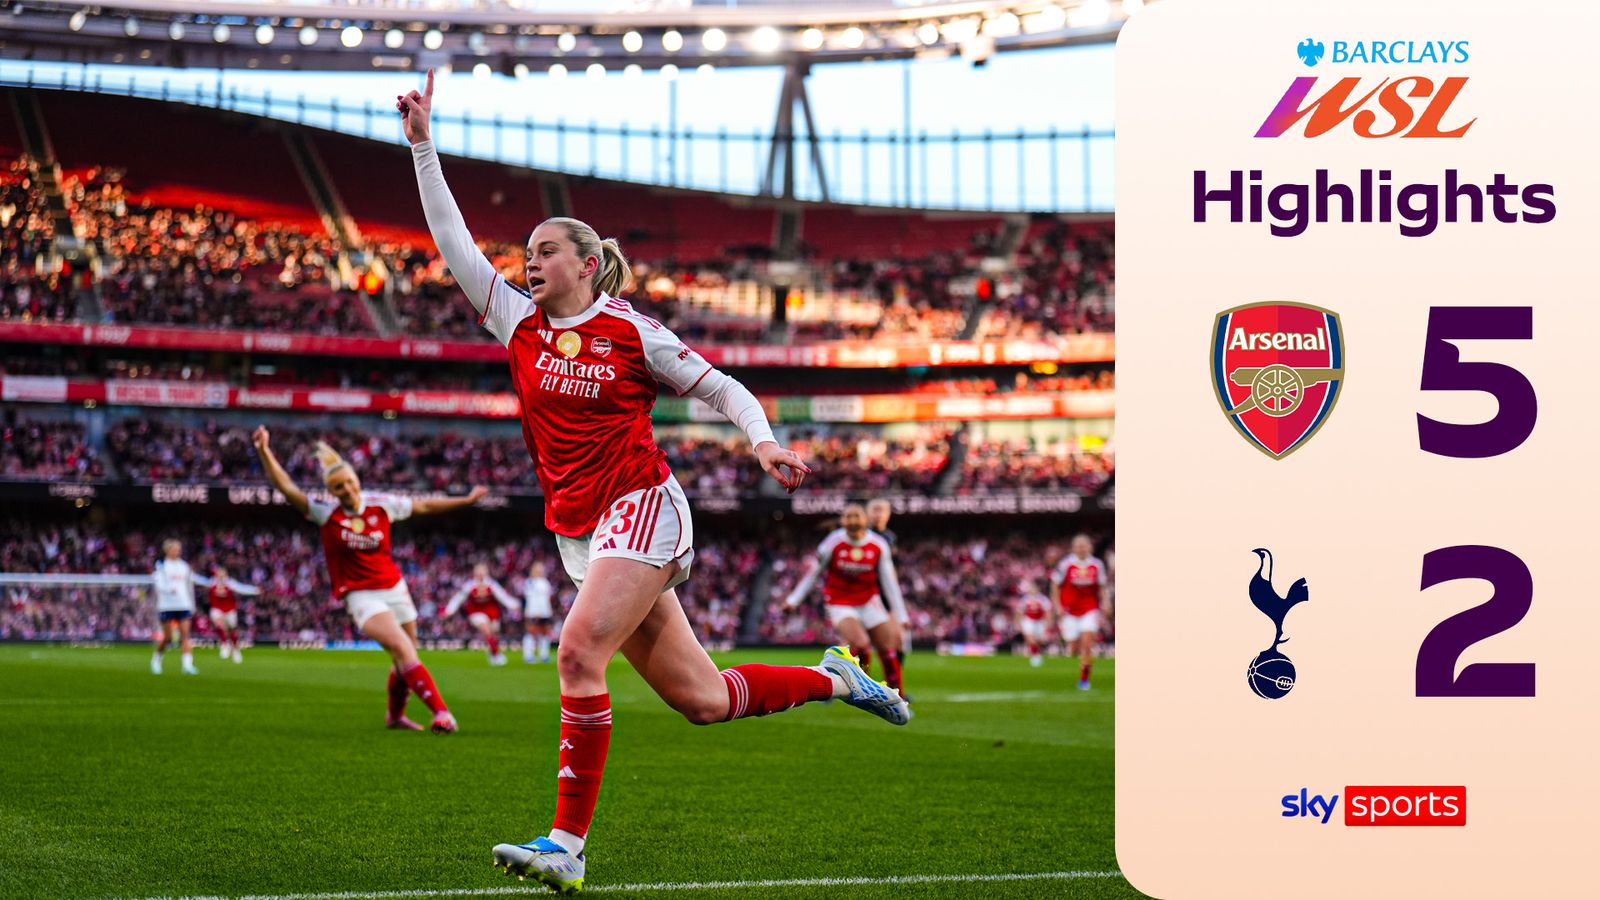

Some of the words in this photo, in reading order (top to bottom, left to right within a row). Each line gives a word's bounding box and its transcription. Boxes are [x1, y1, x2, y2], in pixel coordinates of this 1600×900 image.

[535, 351, 616, 381] Emirates
[540, 373, 560, 391] FLY
[559, 377, 601, 399] BETTER
[595, 500, 637, 541] 23
